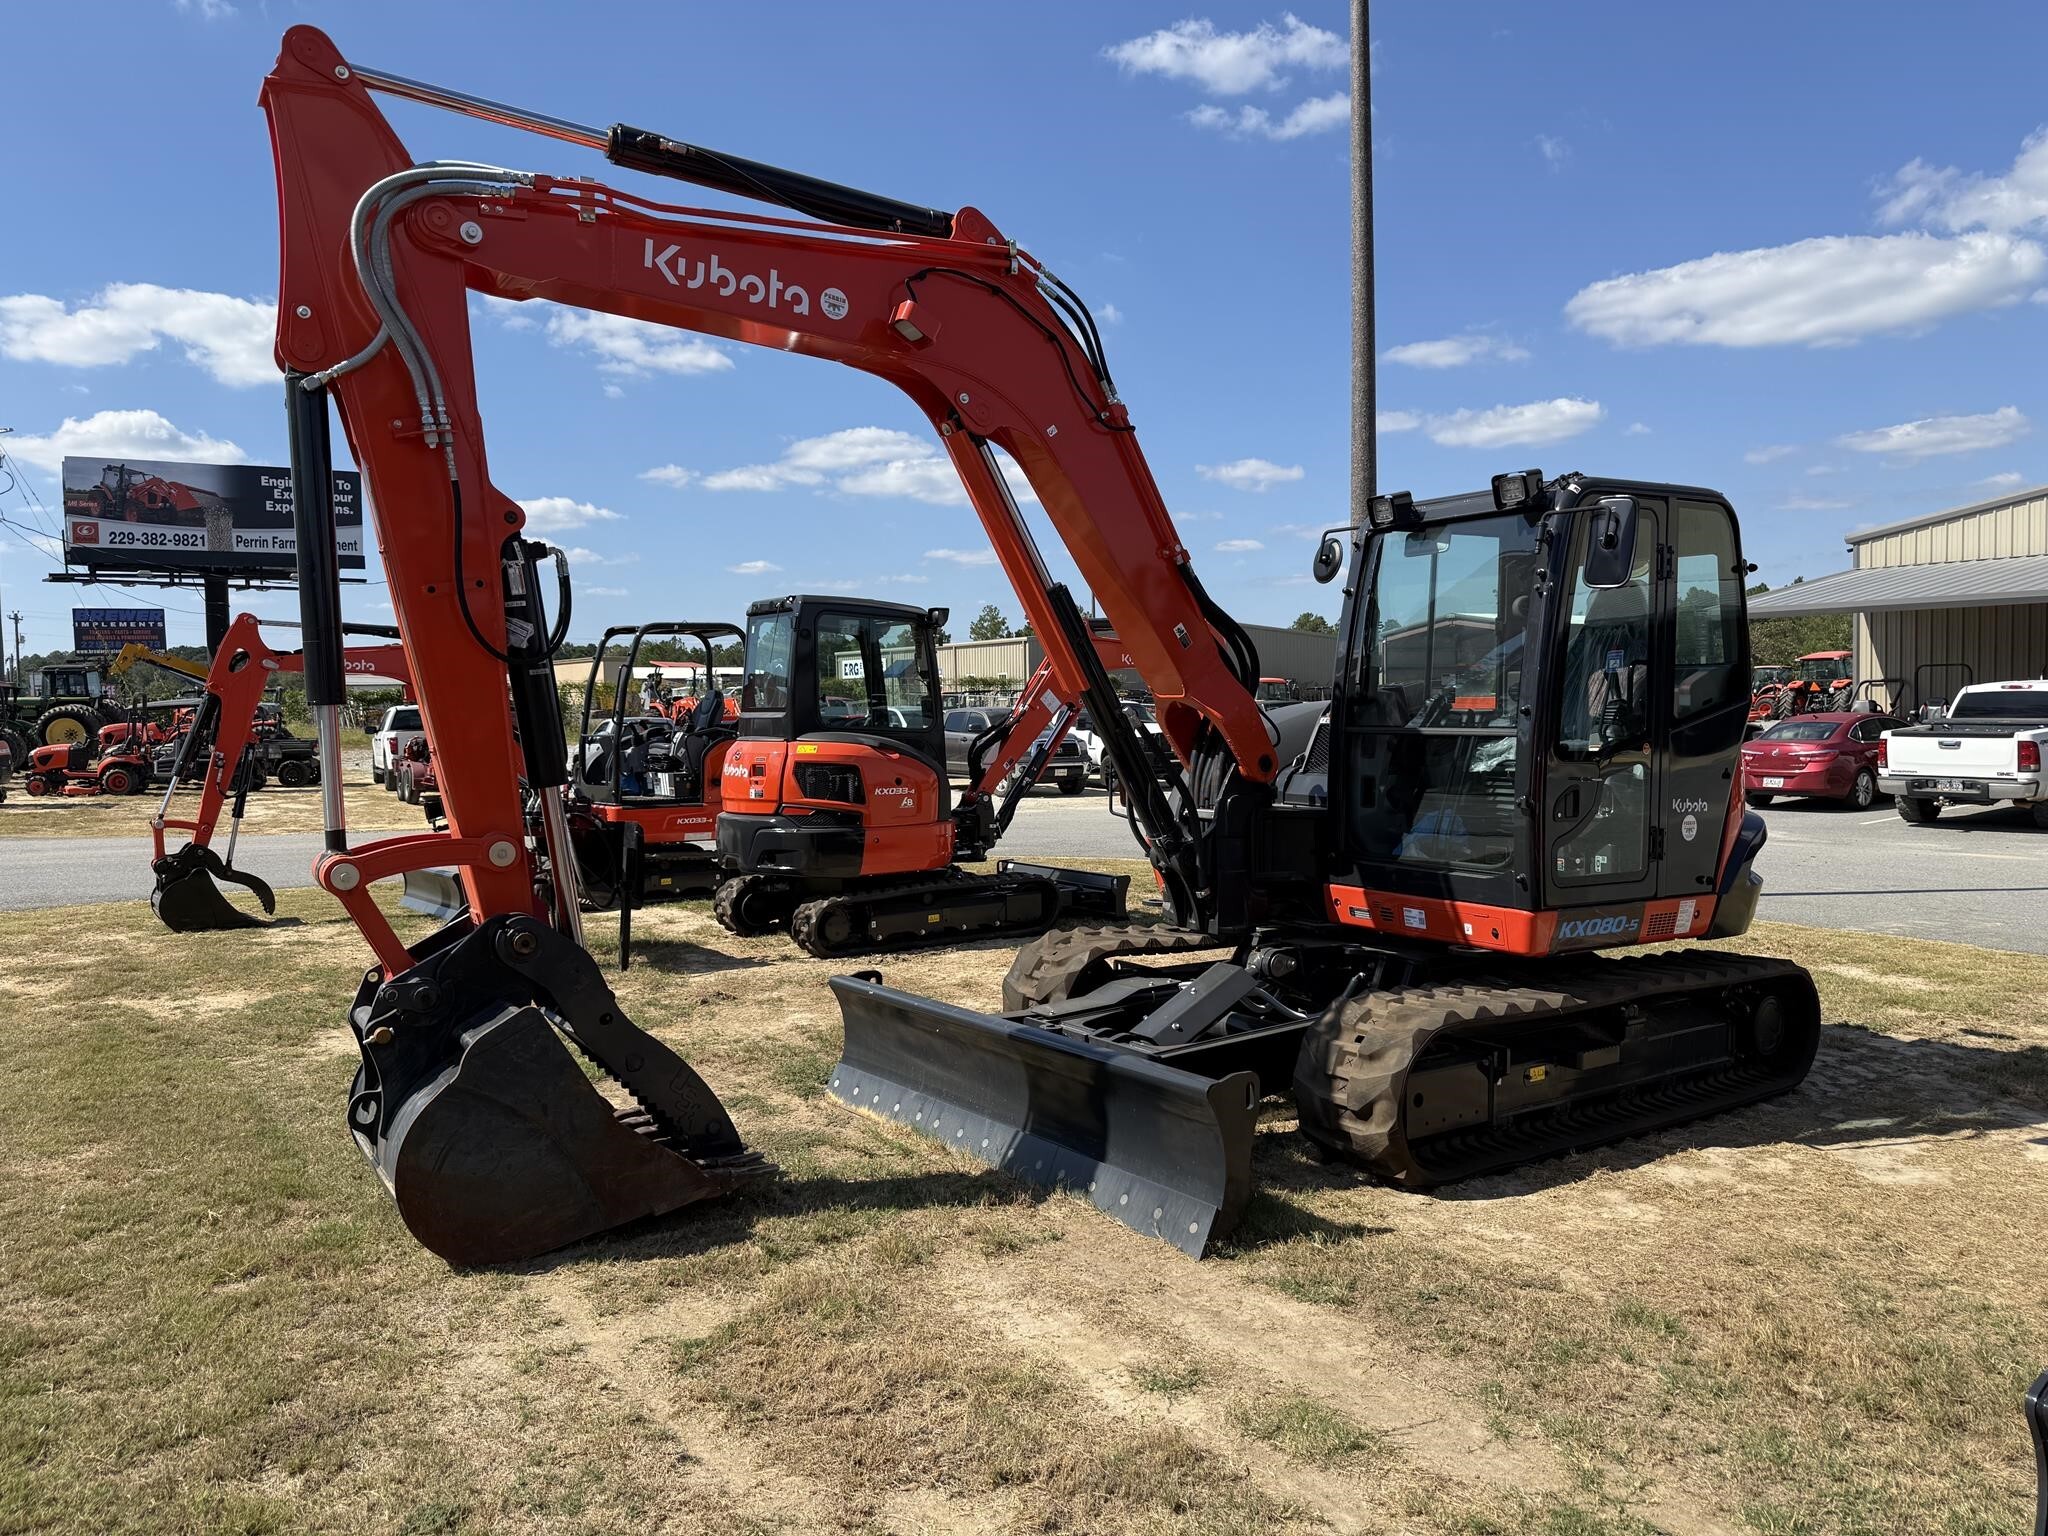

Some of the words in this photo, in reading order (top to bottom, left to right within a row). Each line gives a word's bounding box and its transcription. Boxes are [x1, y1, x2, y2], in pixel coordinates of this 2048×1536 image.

[644, 238, 810, 316] Kubota
[335, 480, 352, 490] To
[333, 494, 354, 503] our
[108, 531, 206, 547] 229-382-9821
[235, 534, 269, 549] Perrin
[344, 659, 376, 671] bota
[844, 662, 860, 676] ERG
[874, 787, 916, 796] KX033-4
[1672, 797, 1708, 813] Kubota
[1558, 915, 1640, 939] KX080-5
